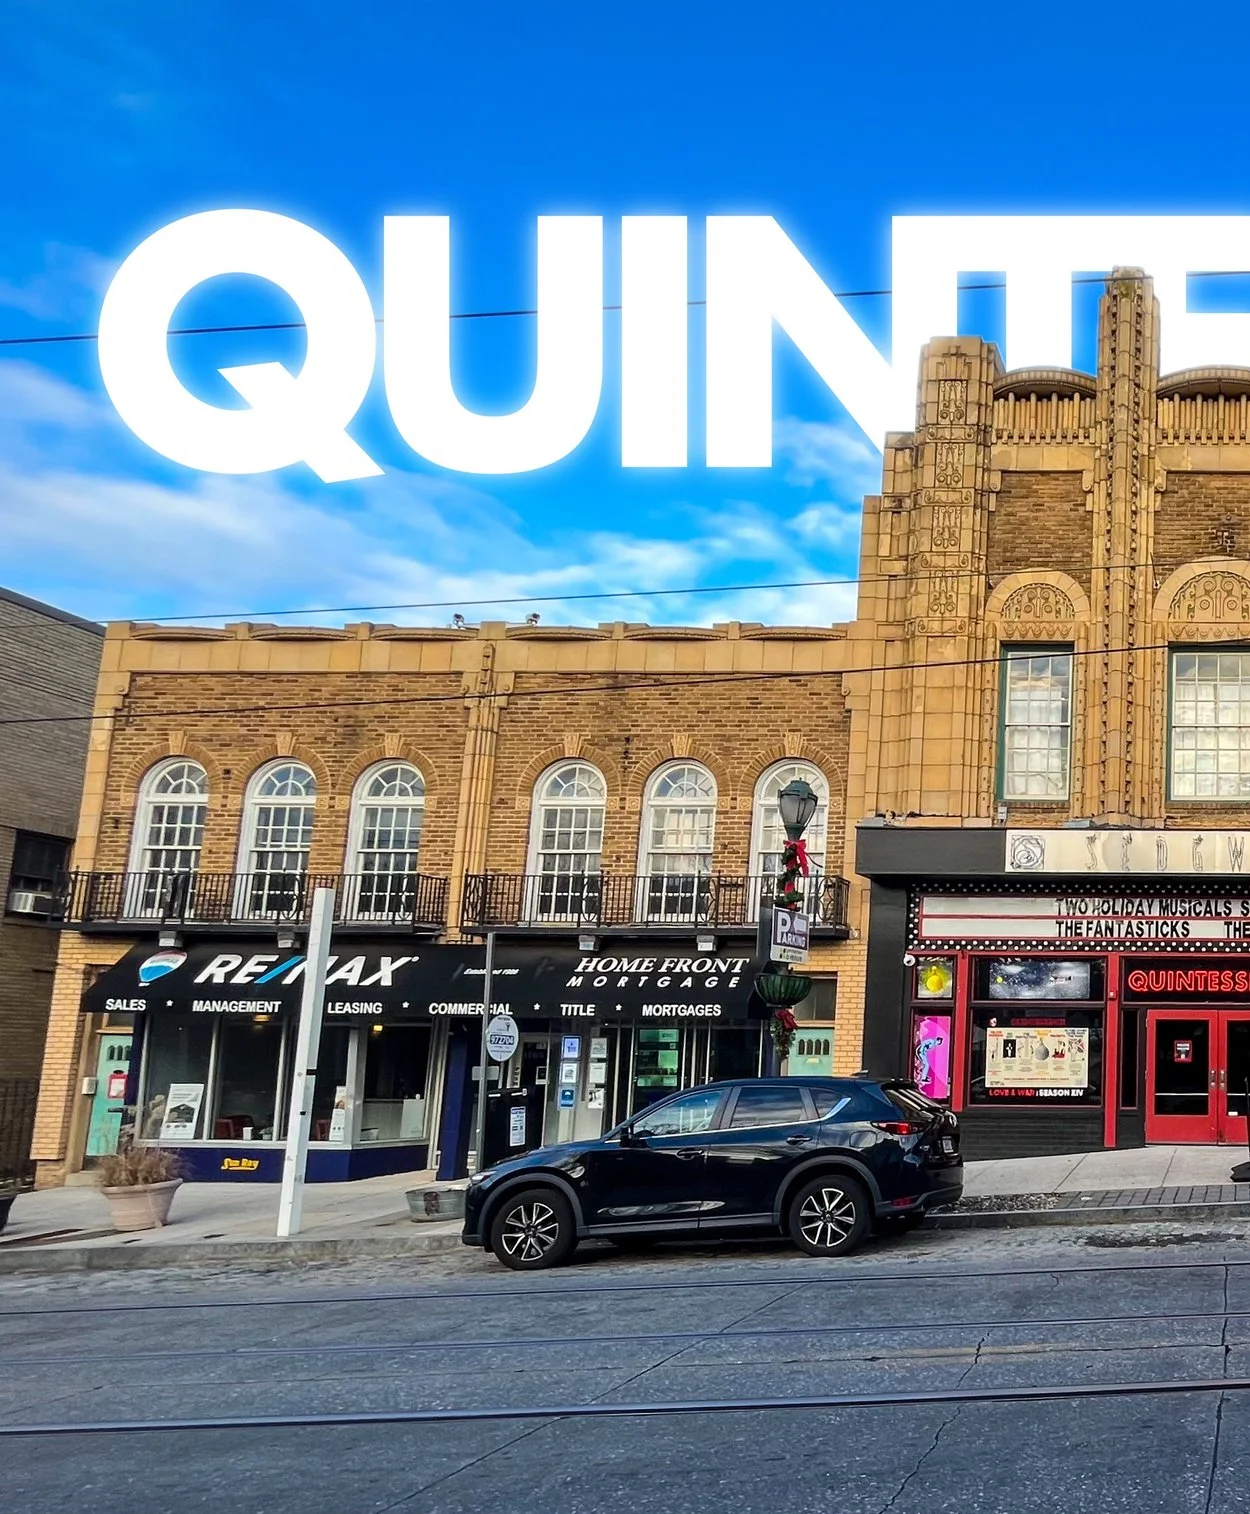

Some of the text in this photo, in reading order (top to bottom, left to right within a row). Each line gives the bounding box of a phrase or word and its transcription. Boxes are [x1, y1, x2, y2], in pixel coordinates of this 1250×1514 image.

[1055, 899, 1089, 916] TWO
[1092, 899, 1155, 917] HOLIDAY
[1158, 899, 1232, 918] MUSICALS
[776, 911, 807, 948] PARKING
[1055, 921, 1083, 937] THE
[1086, 920, 1190, 938] FANTASTICKS
[1224, 921, 1250, 938] THE
[574, 957, 750, 973] HOME FRONT
[566, 975, 741, 988] MORTGAGE
[105, 998, 147, 1011] SALES
[192, 1000, 282, 1013] MANAGEMENT
[327, 1002, 383, 1014] LEASING
[560, 1003, 596, 1016] TITLE
[642, 1003, 722, 1017] MORTGAGES
[989, 1089, 1009, 1097] LOVE
